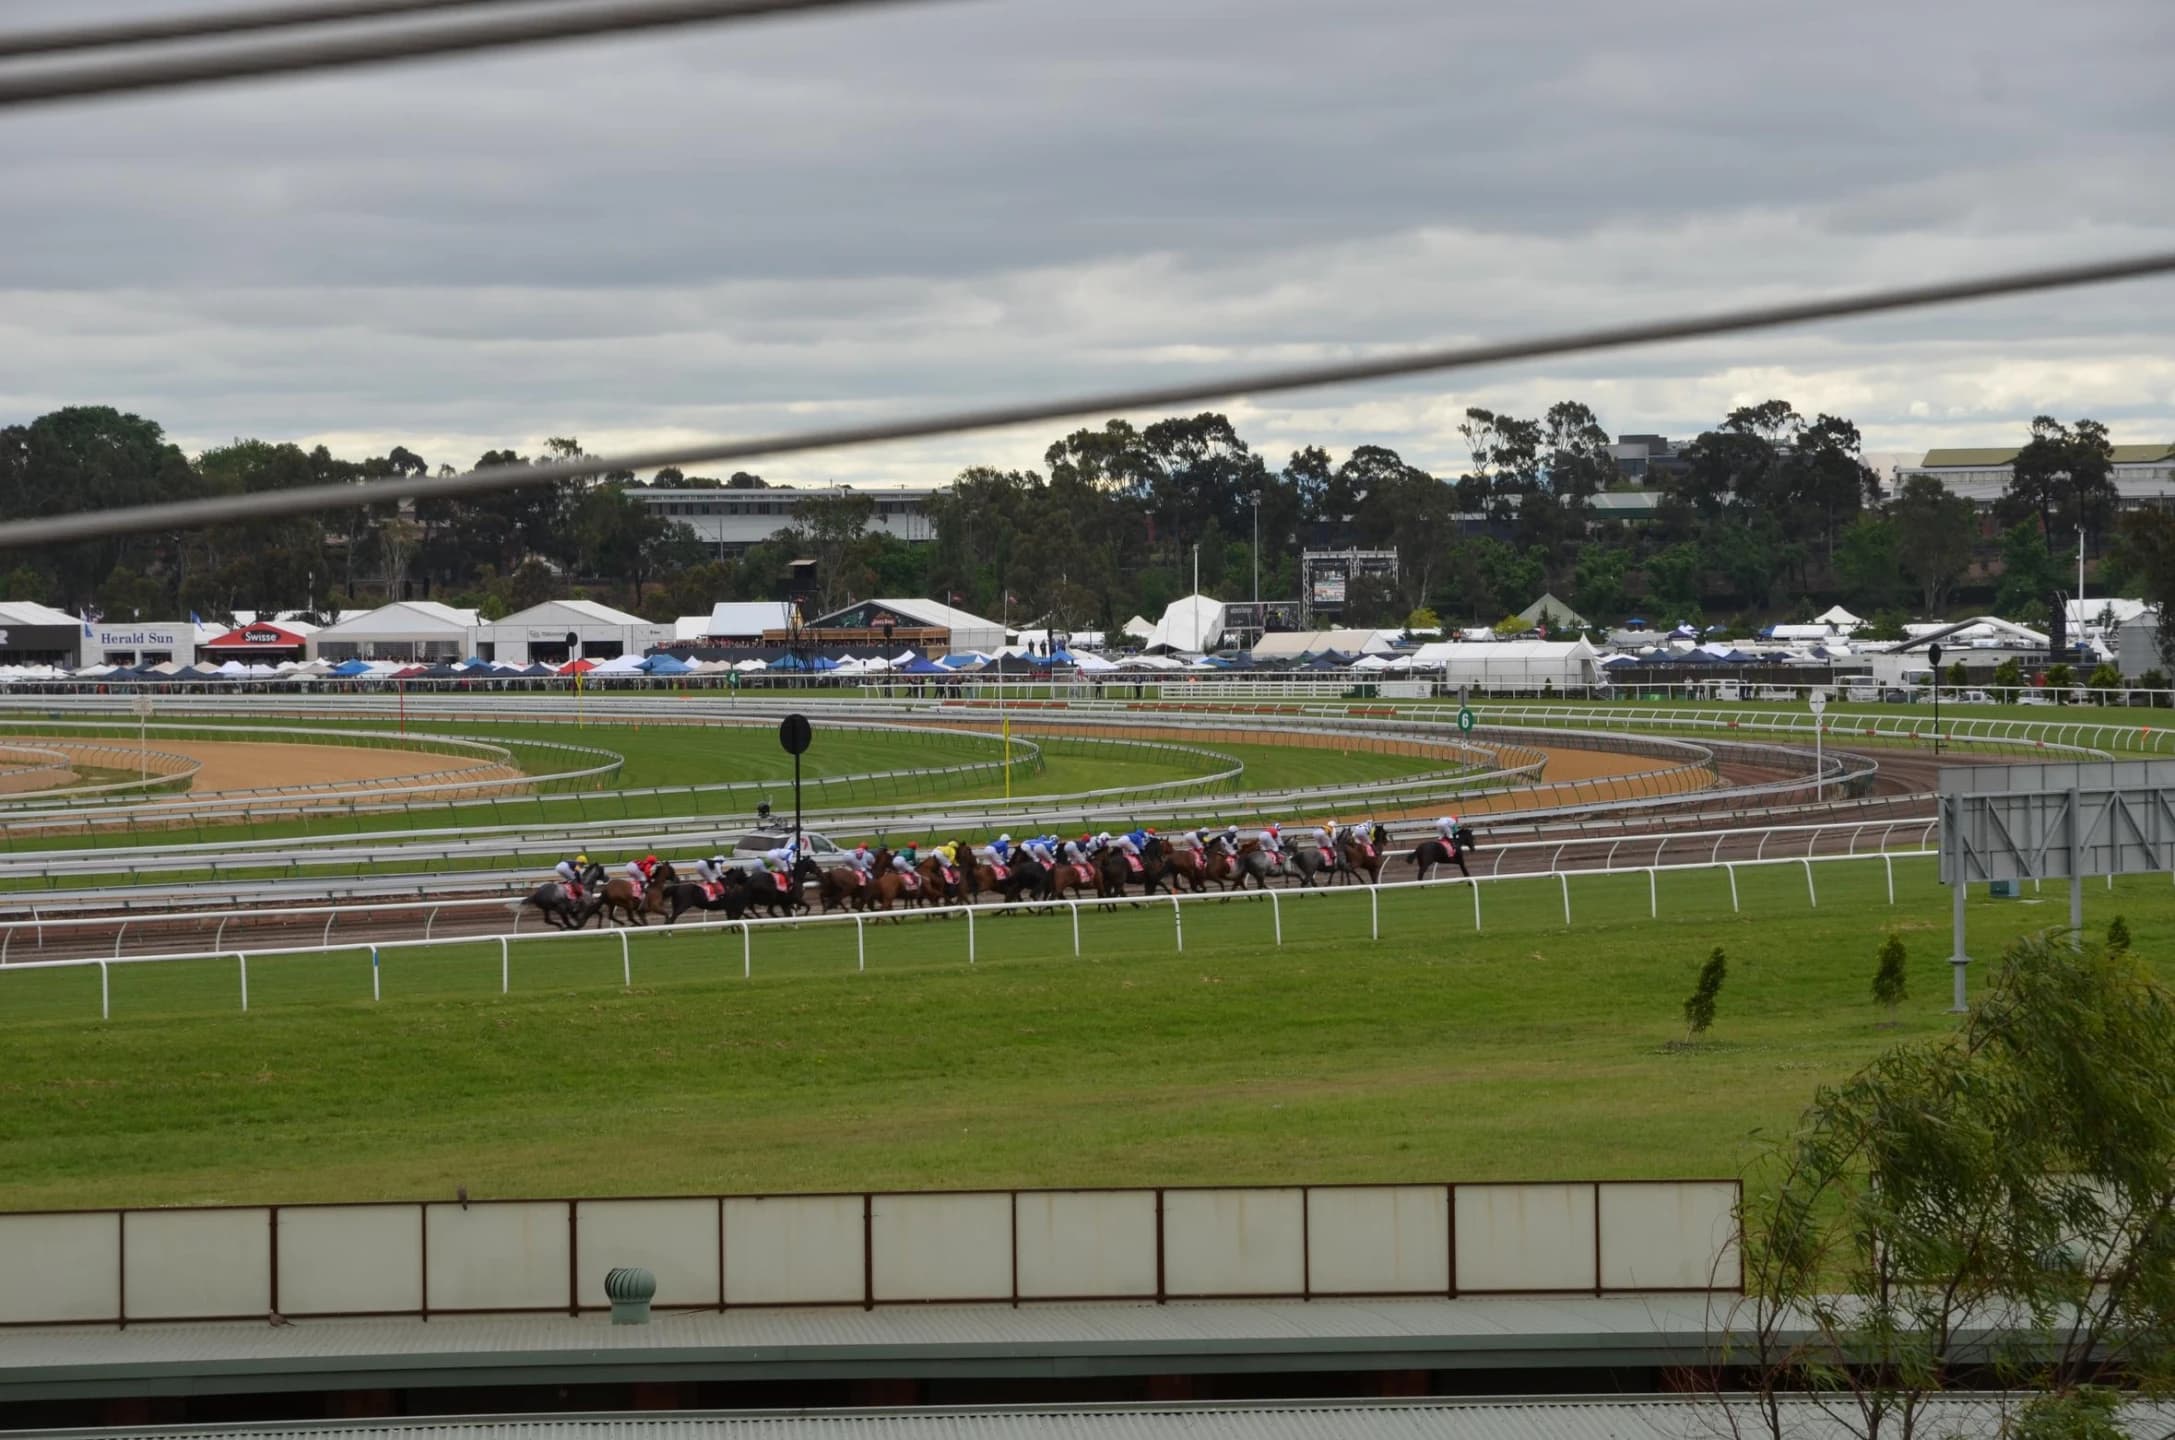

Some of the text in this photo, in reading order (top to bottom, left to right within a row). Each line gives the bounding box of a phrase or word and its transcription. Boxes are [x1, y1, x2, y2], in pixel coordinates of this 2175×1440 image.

[101, 632, 174, 644] Herald Sun
[245, 631, 277, 642] Swisse
[1461, 712, 1469, 728] 6
